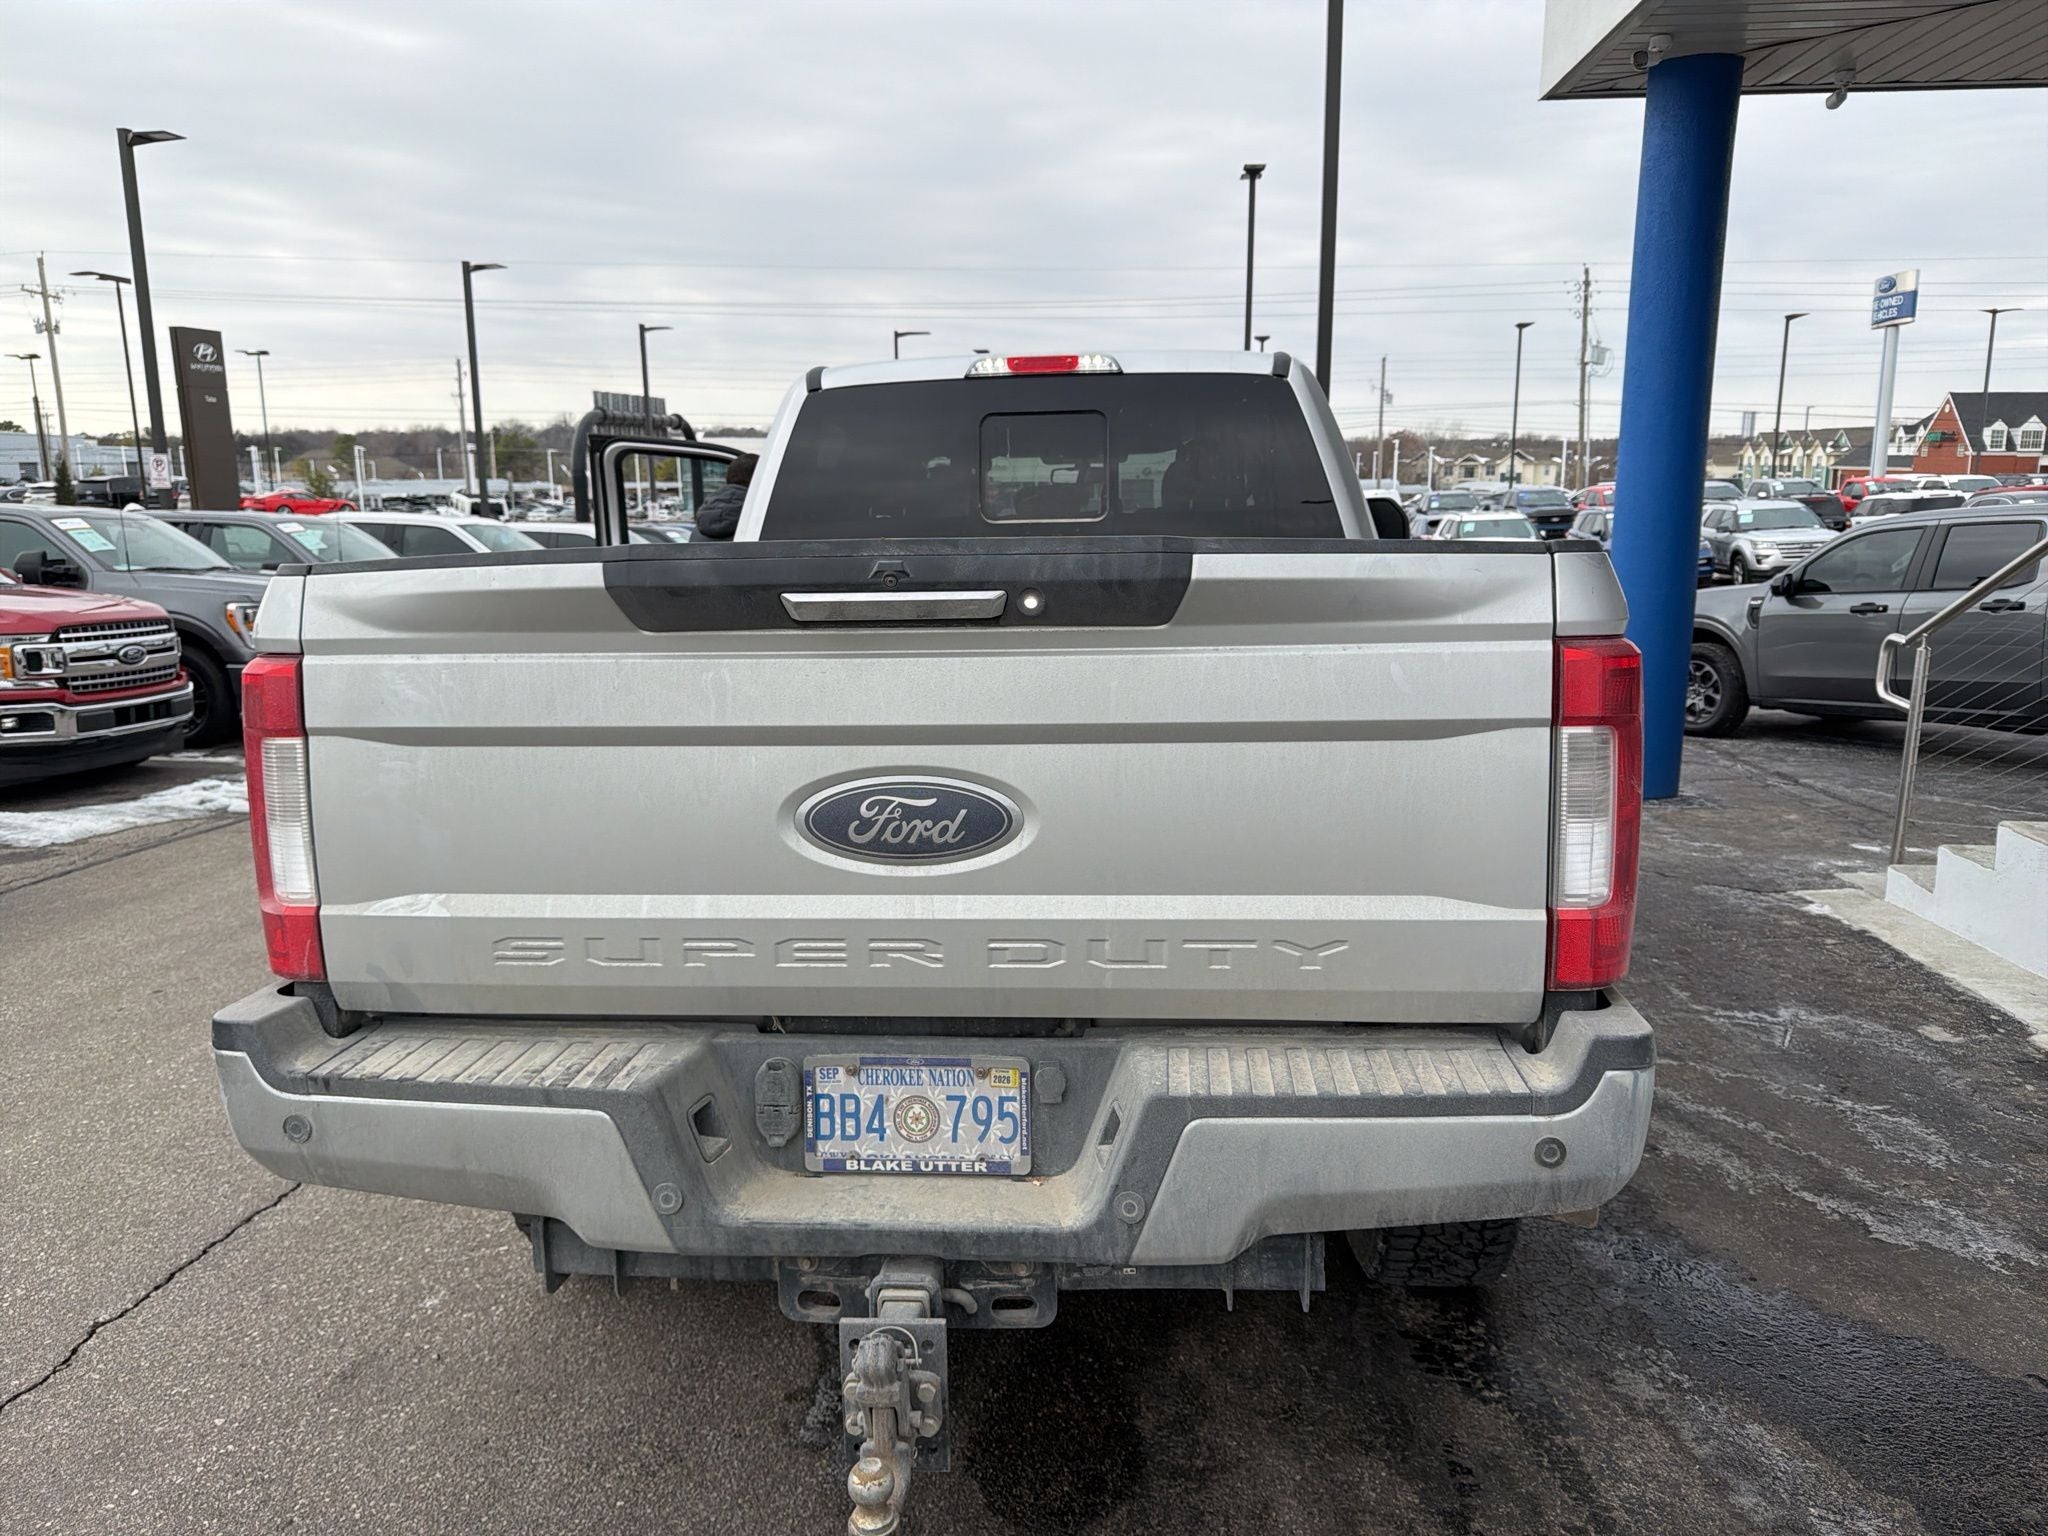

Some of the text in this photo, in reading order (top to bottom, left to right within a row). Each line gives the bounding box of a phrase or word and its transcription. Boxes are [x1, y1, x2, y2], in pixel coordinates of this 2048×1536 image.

[1873, 295, 1904, 310] E-OWNED
[848, 795, 968, 844] Ford
[493, 936, 1349, 970] SUPER DUTY
[819, 1067, 839, 1080] SEP
[857, 1067, 975, 1087] CHEROKEE NATION
[806, 1085, 813, 1097] TX
[815, 1093, 888, 1142] BB4
[945, 1095, 1020, 1145] 795
[845, 1160, 987, 1172] BLAKE UTTER
